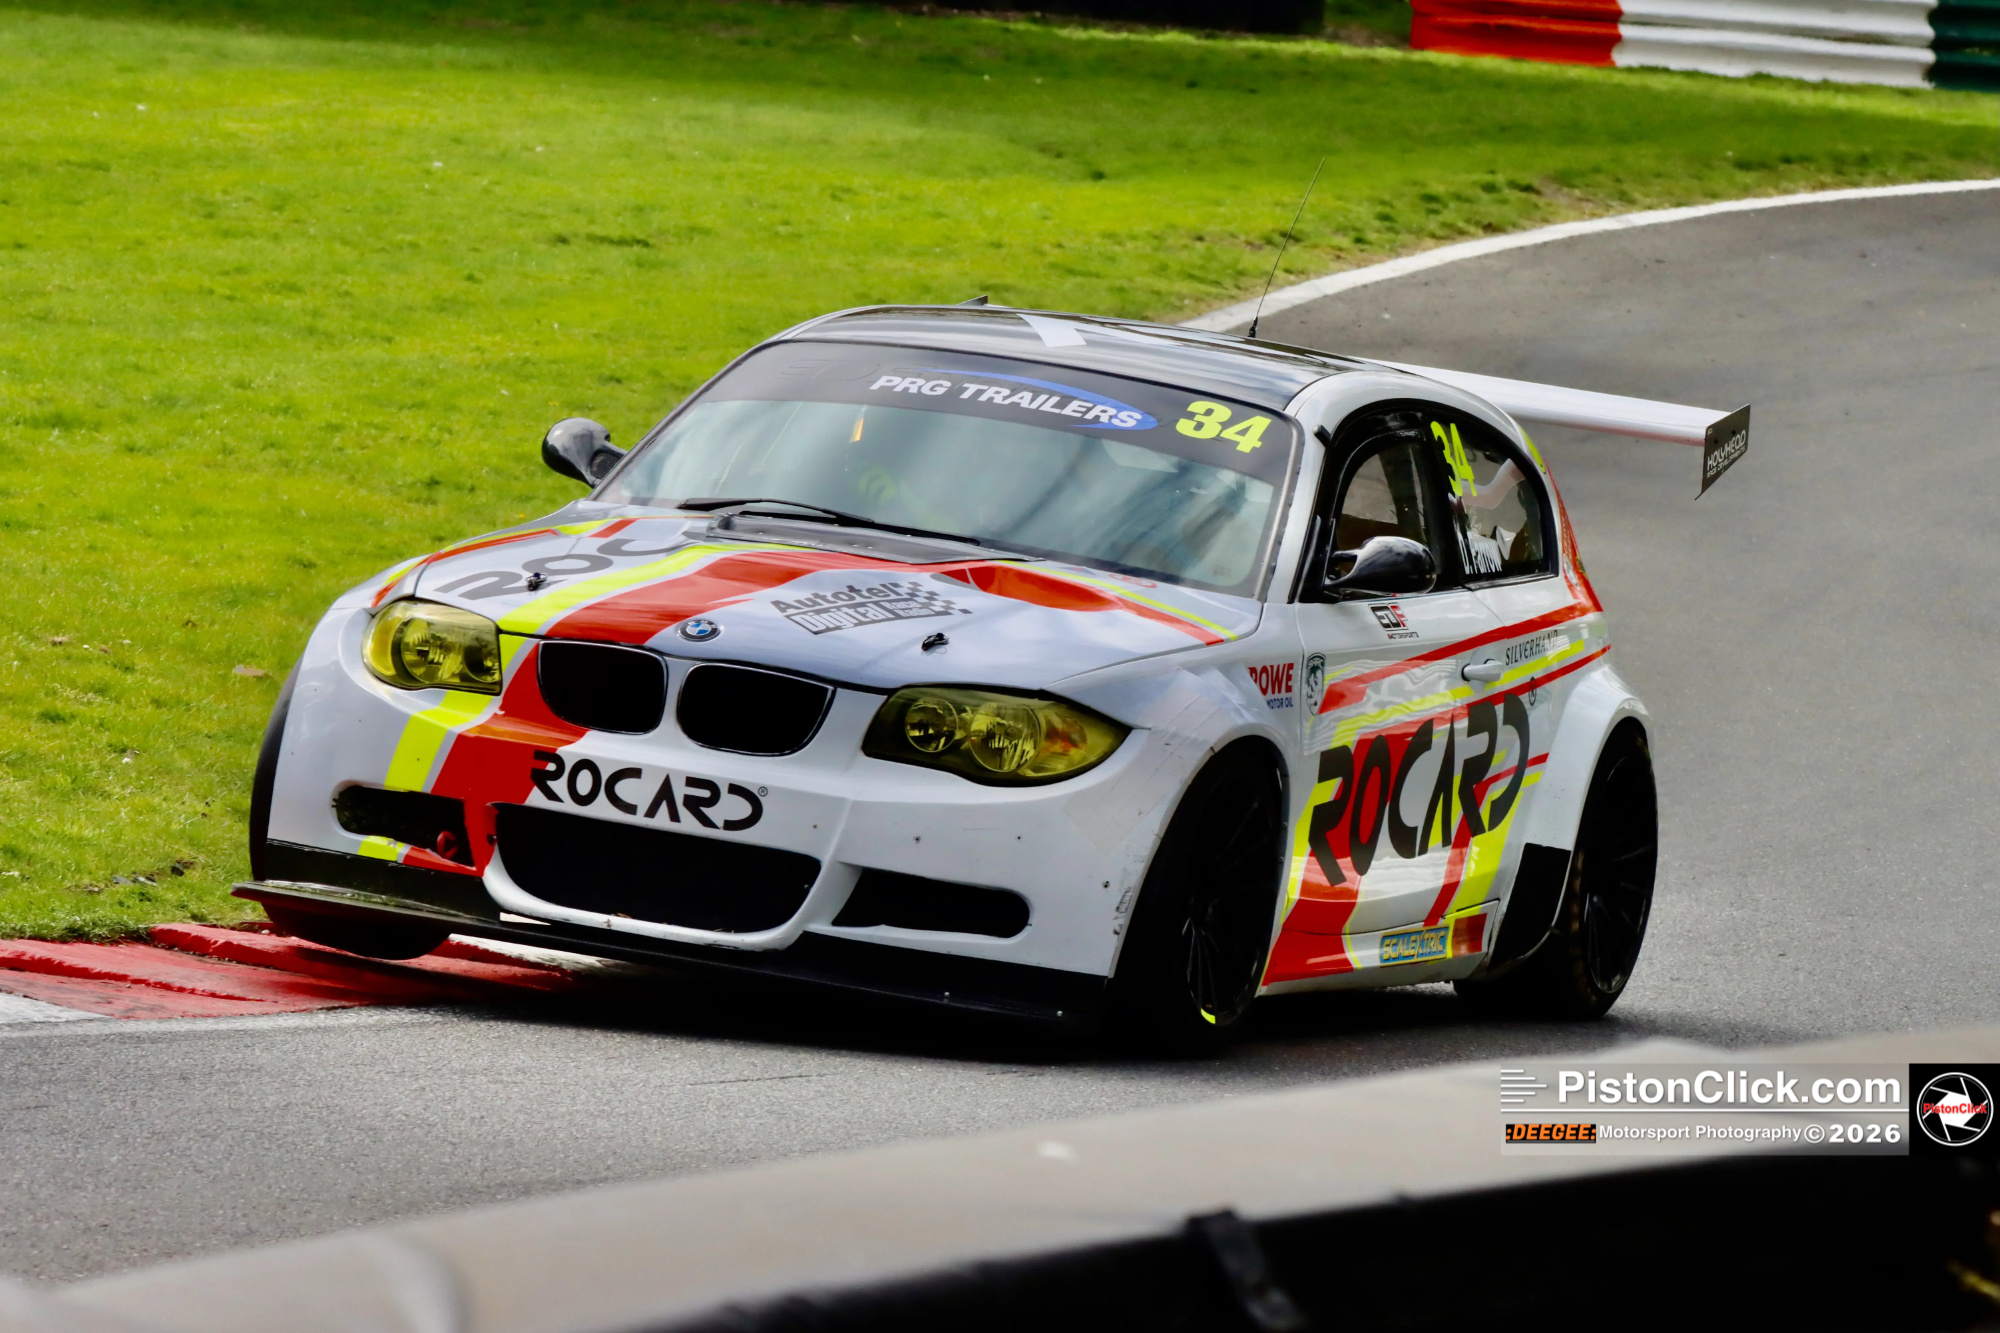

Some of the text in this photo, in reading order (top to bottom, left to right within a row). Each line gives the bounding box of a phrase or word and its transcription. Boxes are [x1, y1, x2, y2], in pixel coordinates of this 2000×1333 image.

[869, 375, 1142, 428] PRG TRAILERS
[1175, 400, 1272, 454] 34
[1430, 421, 1477, 497] 34
[433, 530, 722, 601] ROC
[770, 583, 900, 614] Autotel
[790, 602, 895, 632] Digital
[1382, 929, 1446, 960] SCALEXTRIC
